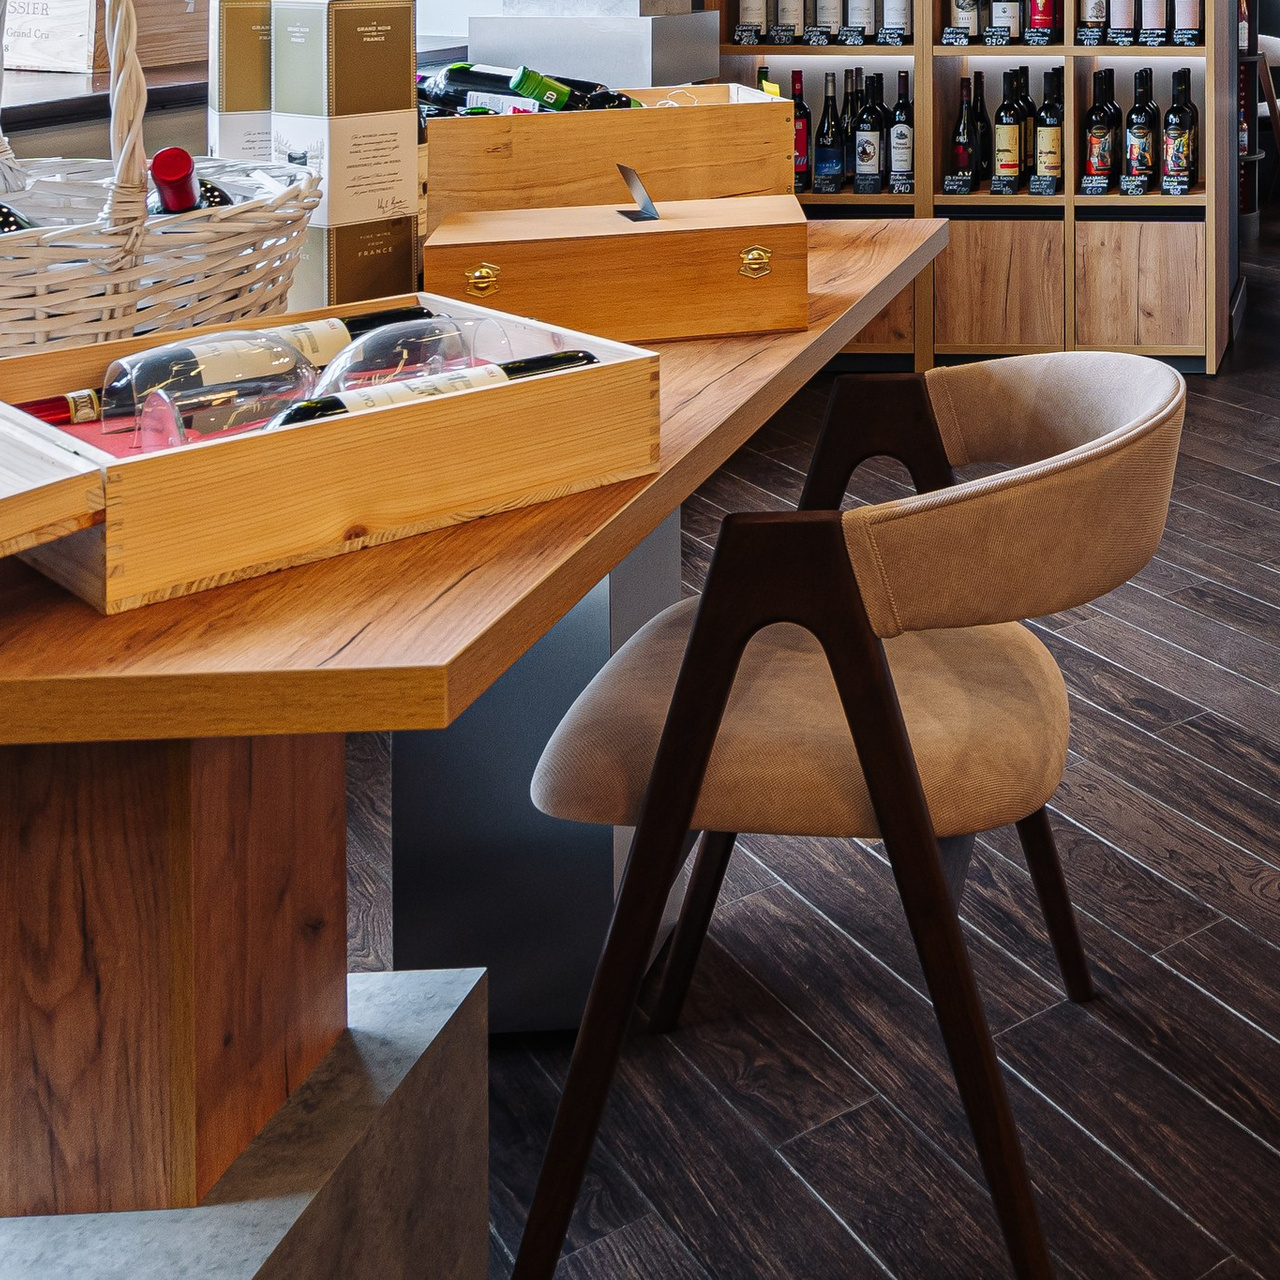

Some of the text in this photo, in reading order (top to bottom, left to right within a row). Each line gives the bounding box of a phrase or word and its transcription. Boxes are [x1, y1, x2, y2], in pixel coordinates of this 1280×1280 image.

[6, 27, 50, 39] Grand Cru
[893, 183, 911, 193] 840
[358, 246, 393, 257] FRANCE
